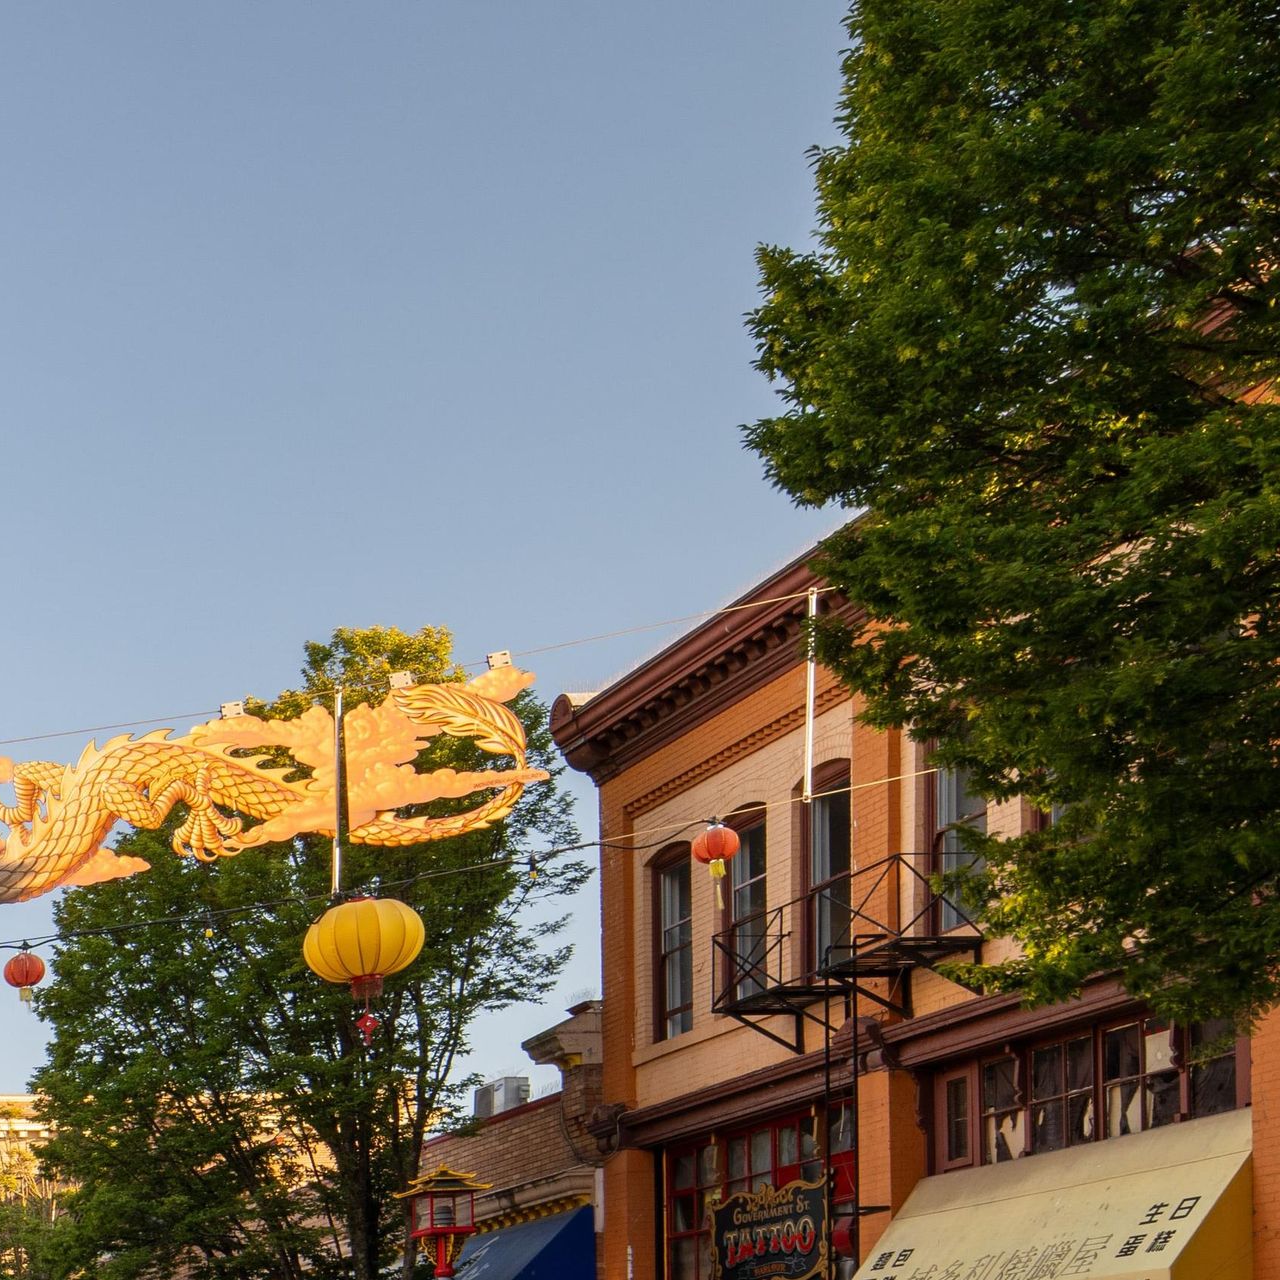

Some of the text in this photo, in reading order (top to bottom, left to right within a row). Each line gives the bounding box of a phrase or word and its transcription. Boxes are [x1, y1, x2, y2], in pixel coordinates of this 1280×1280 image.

[1139, 1196, 1202, 1226] 生日
[723, 1215, 816, 1268] TATTOO
[1115, 1230, 1177, 1259] 蛋糕
